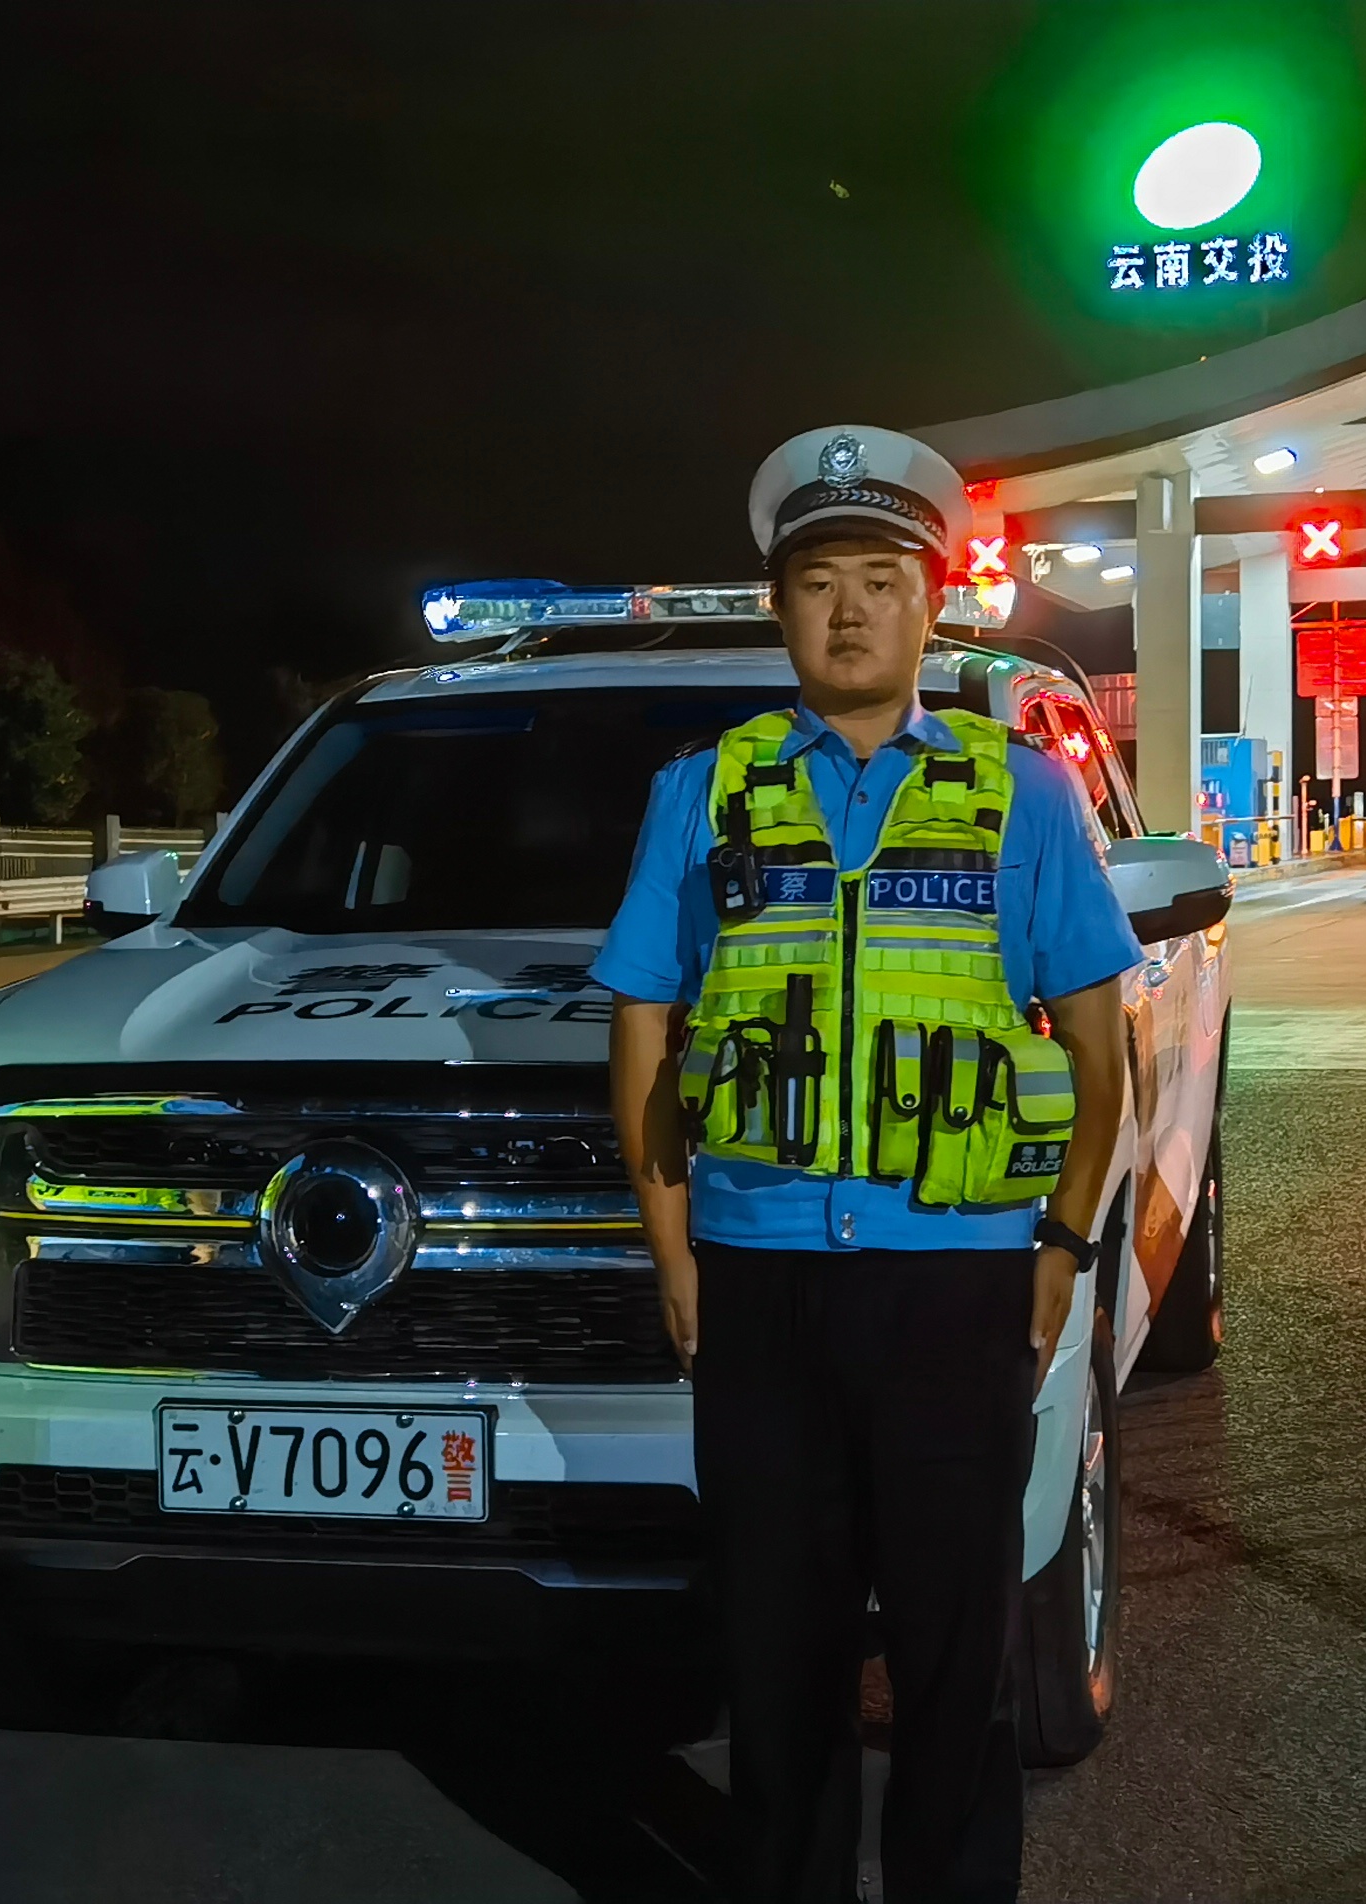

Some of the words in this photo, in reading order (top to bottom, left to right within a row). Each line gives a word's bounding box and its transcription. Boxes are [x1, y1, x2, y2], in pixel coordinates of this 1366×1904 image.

[1107, 233, 1289, 290] 云南交投
[873, 877, 992, 905] POLICE
[214, 996, 612, 1025] POLICE
